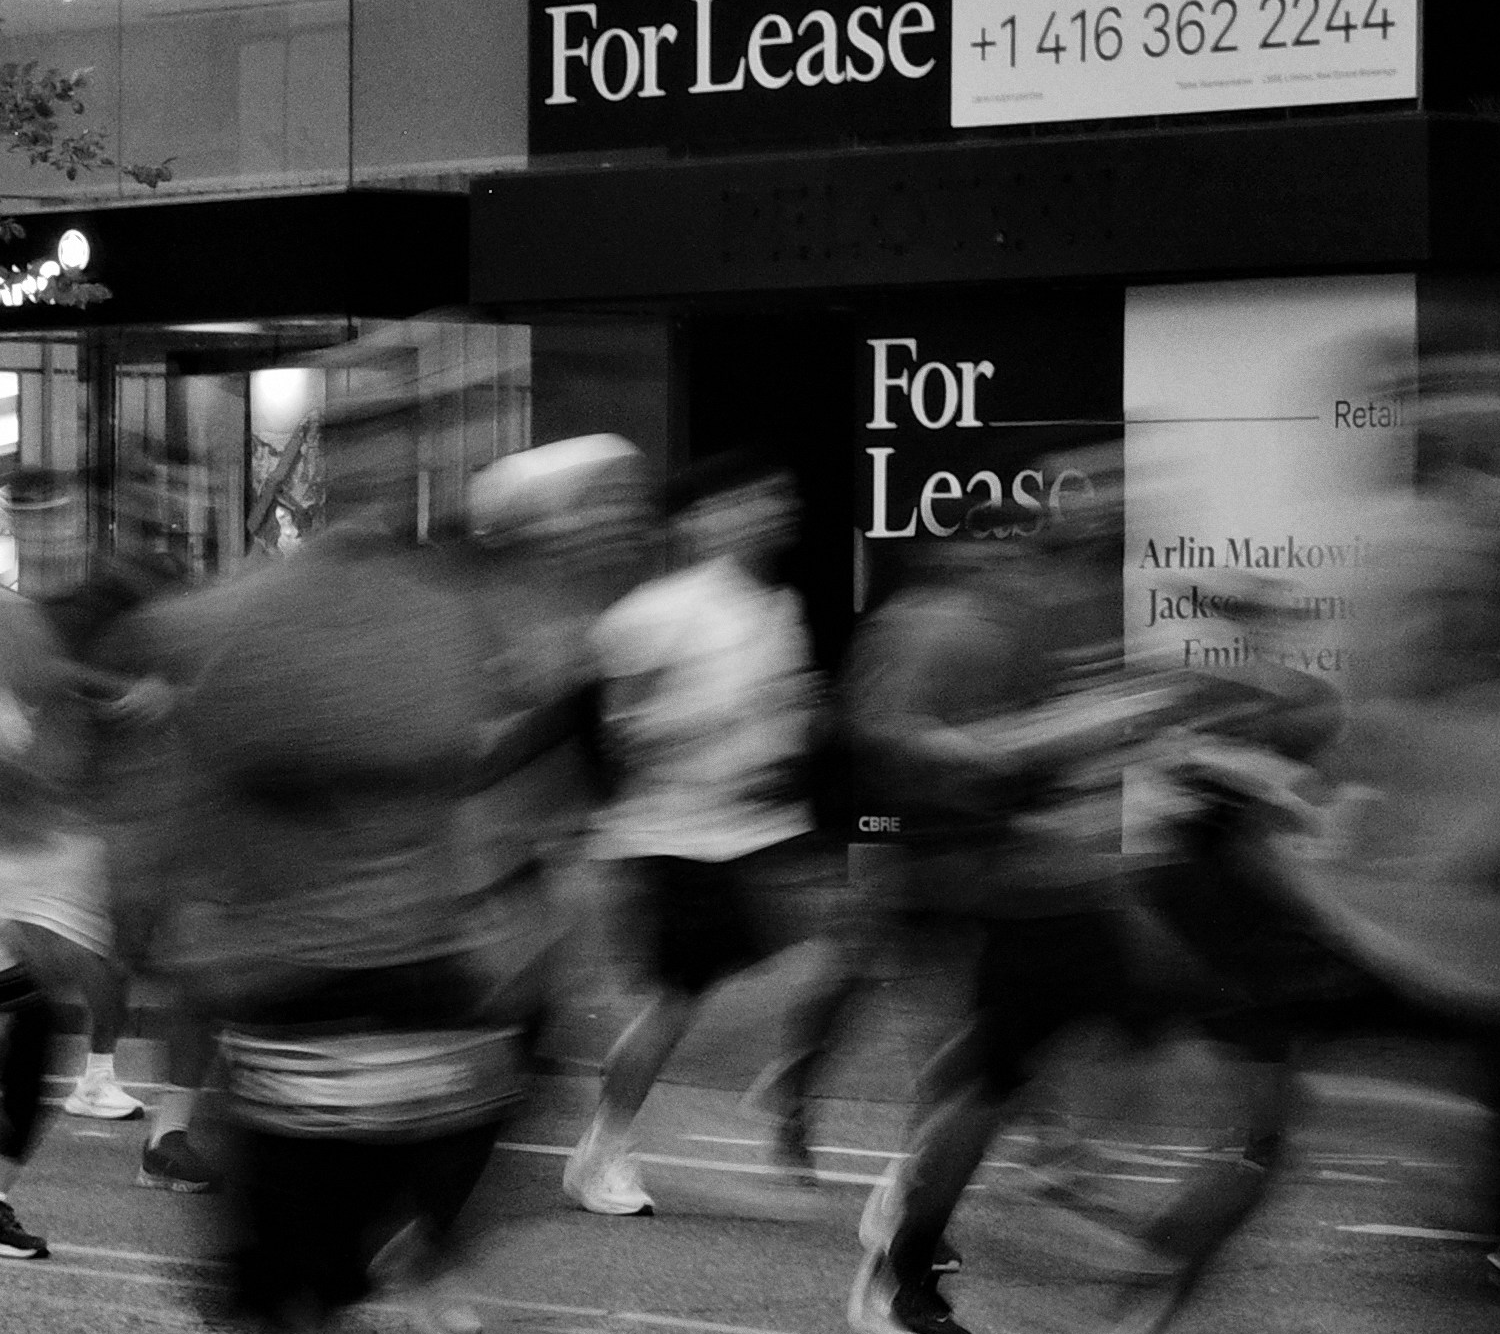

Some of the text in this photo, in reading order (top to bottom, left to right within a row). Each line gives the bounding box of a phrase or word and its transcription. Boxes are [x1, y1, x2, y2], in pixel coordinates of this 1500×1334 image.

[544, 3, 679, 105] For
[970, 14, 1017, 68] +1
[1036, 6, 1123, 64] 416
[865, 338, 995, 429] For
[865, 447, 1096, 539] Lease
[1139, 535, 1216, 569] Arlin
[858, 815, 901, 833] CBRE
